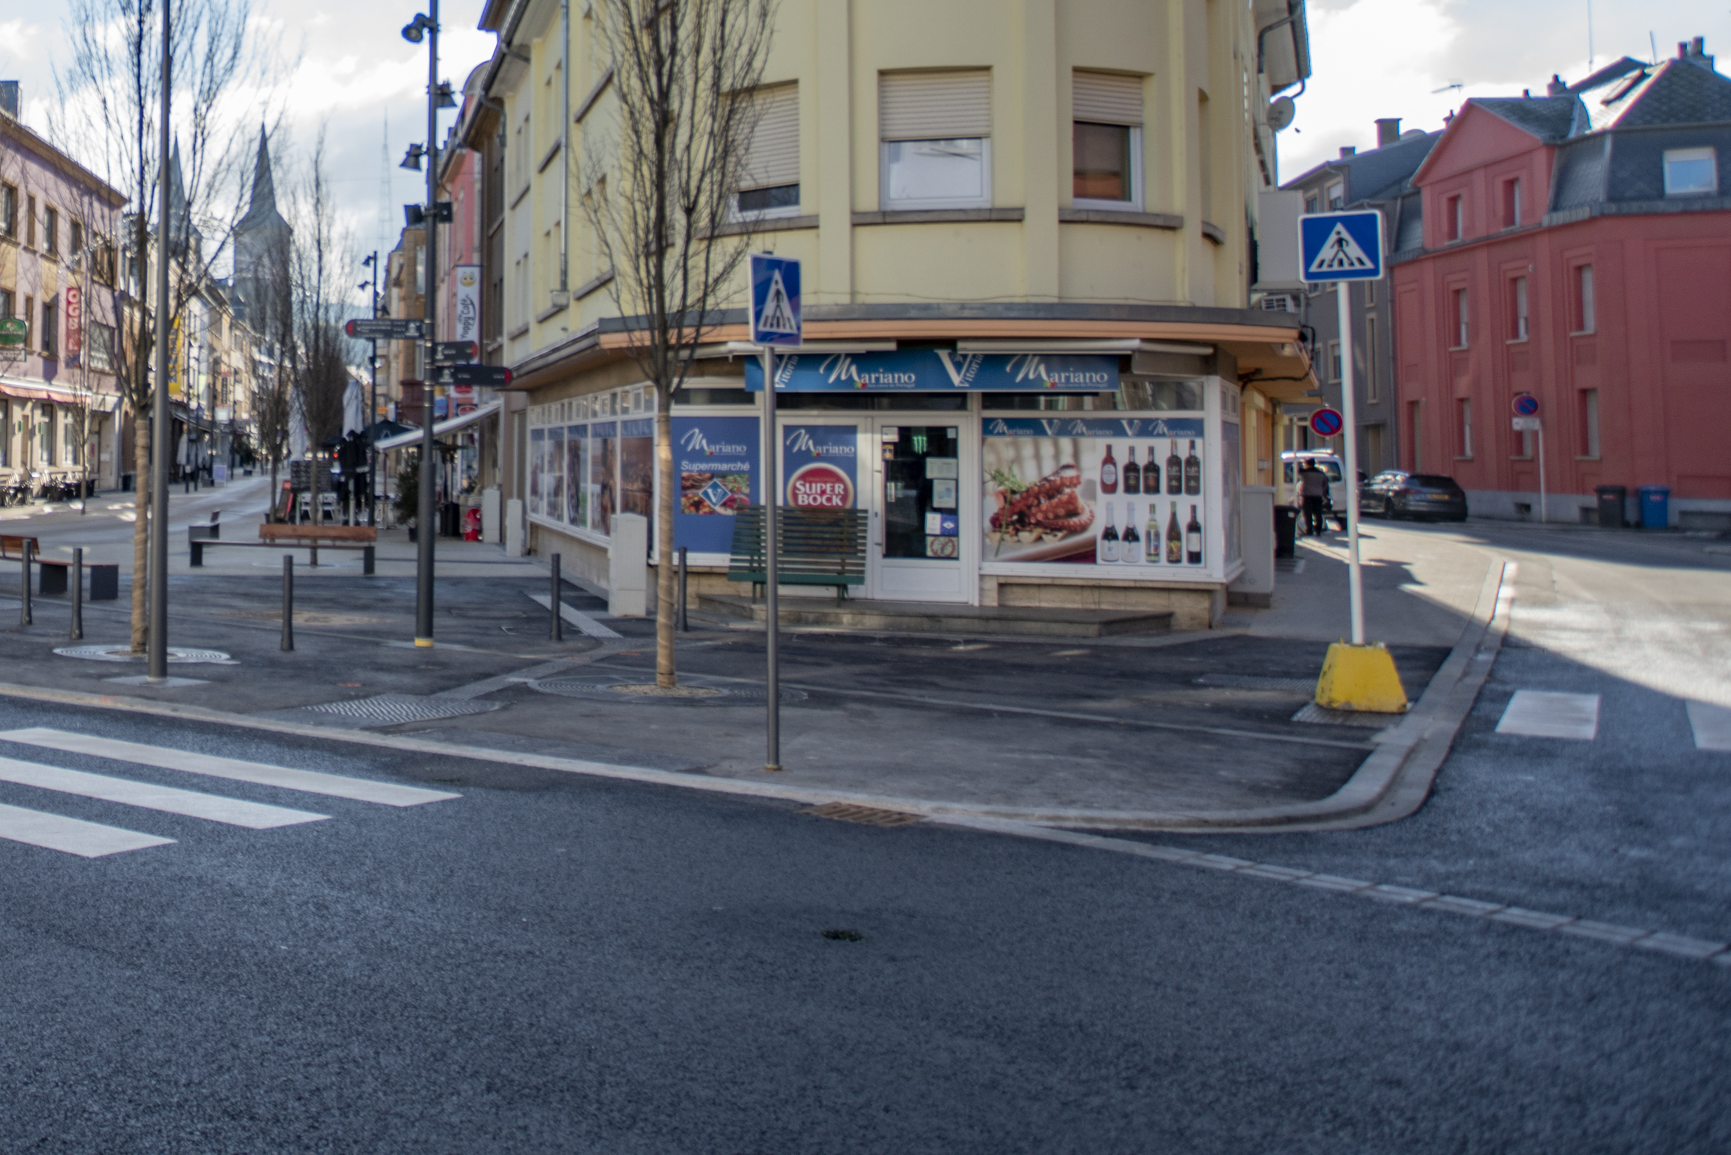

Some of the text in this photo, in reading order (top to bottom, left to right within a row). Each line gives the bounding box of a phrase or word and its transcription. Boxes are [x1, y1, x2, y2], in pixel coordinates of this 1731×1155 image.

[819, 353, 916, 384] Mariano
[1006, 354, 1109, 384] Mariano
[989, 418, 1034, 435] Mariano
[1068, 419, 1114, 435] Mariano
[1148, 419, 1196, 435] Mariano
[680, 427, 747, 455] Mariano
[786, 428, 855, 455] Mariano
[680, 460, 750, 472] Supermarché
[795, 480, 845, 496] SUPER
[797, 494, 844, 507] BOCK
